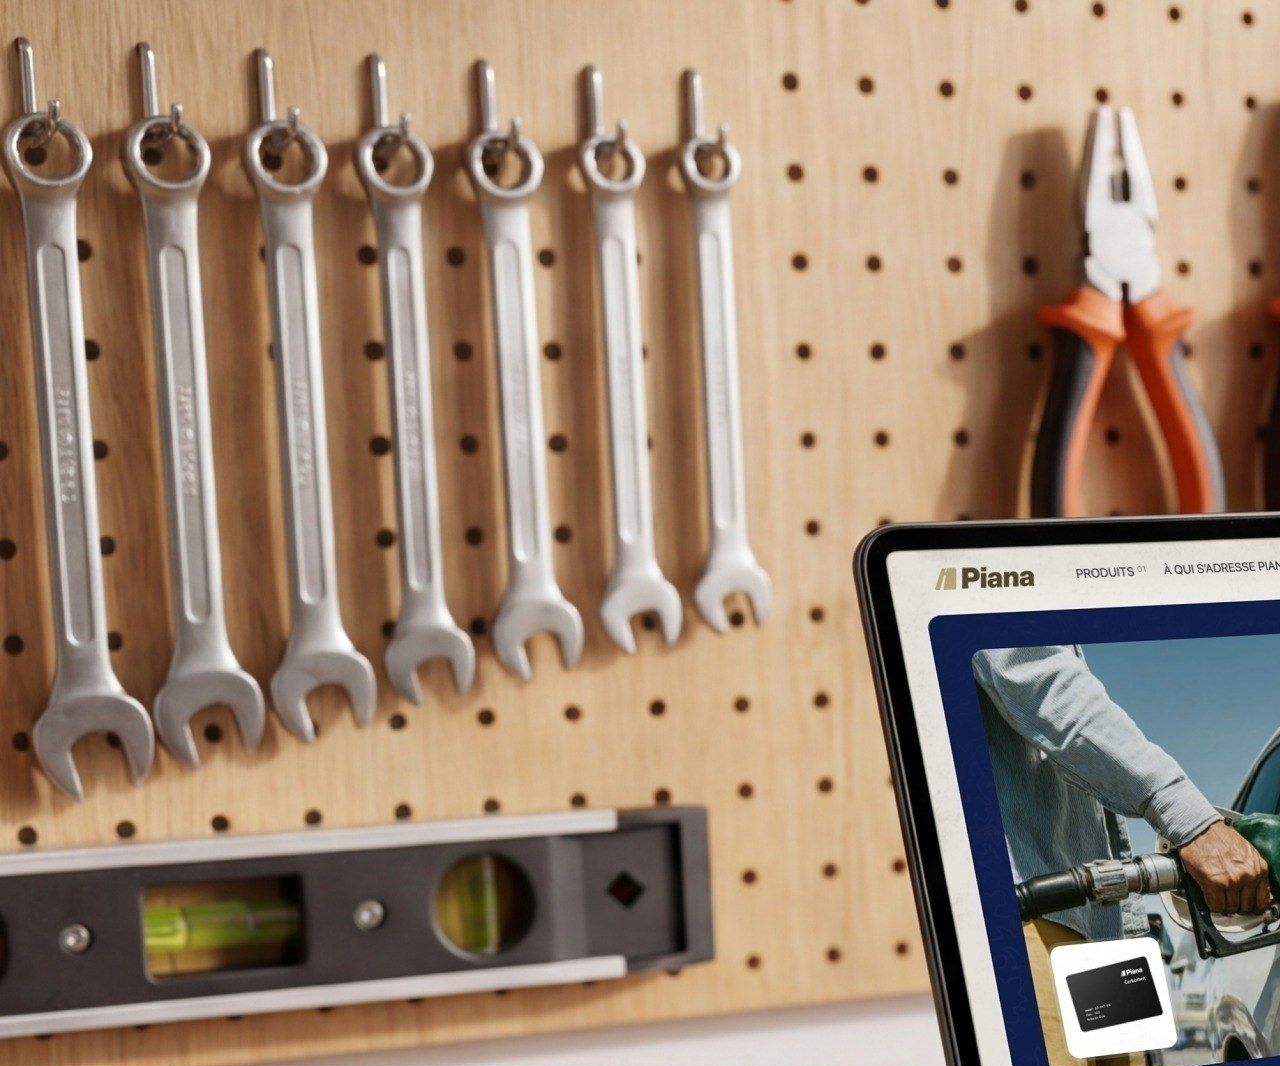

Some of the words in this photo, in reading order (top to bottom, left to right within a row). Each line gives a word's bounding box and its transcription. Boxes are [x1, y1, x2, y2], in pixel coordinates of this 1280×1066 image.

[1076, 566, 1135, 578] PRODUITS
[1137, 565, 1146, 573] 01
[1164, 563, 1172, 575] À
[1174, 564, 1194, 575] QUI
[961, 567, 1035, 589] Piana
